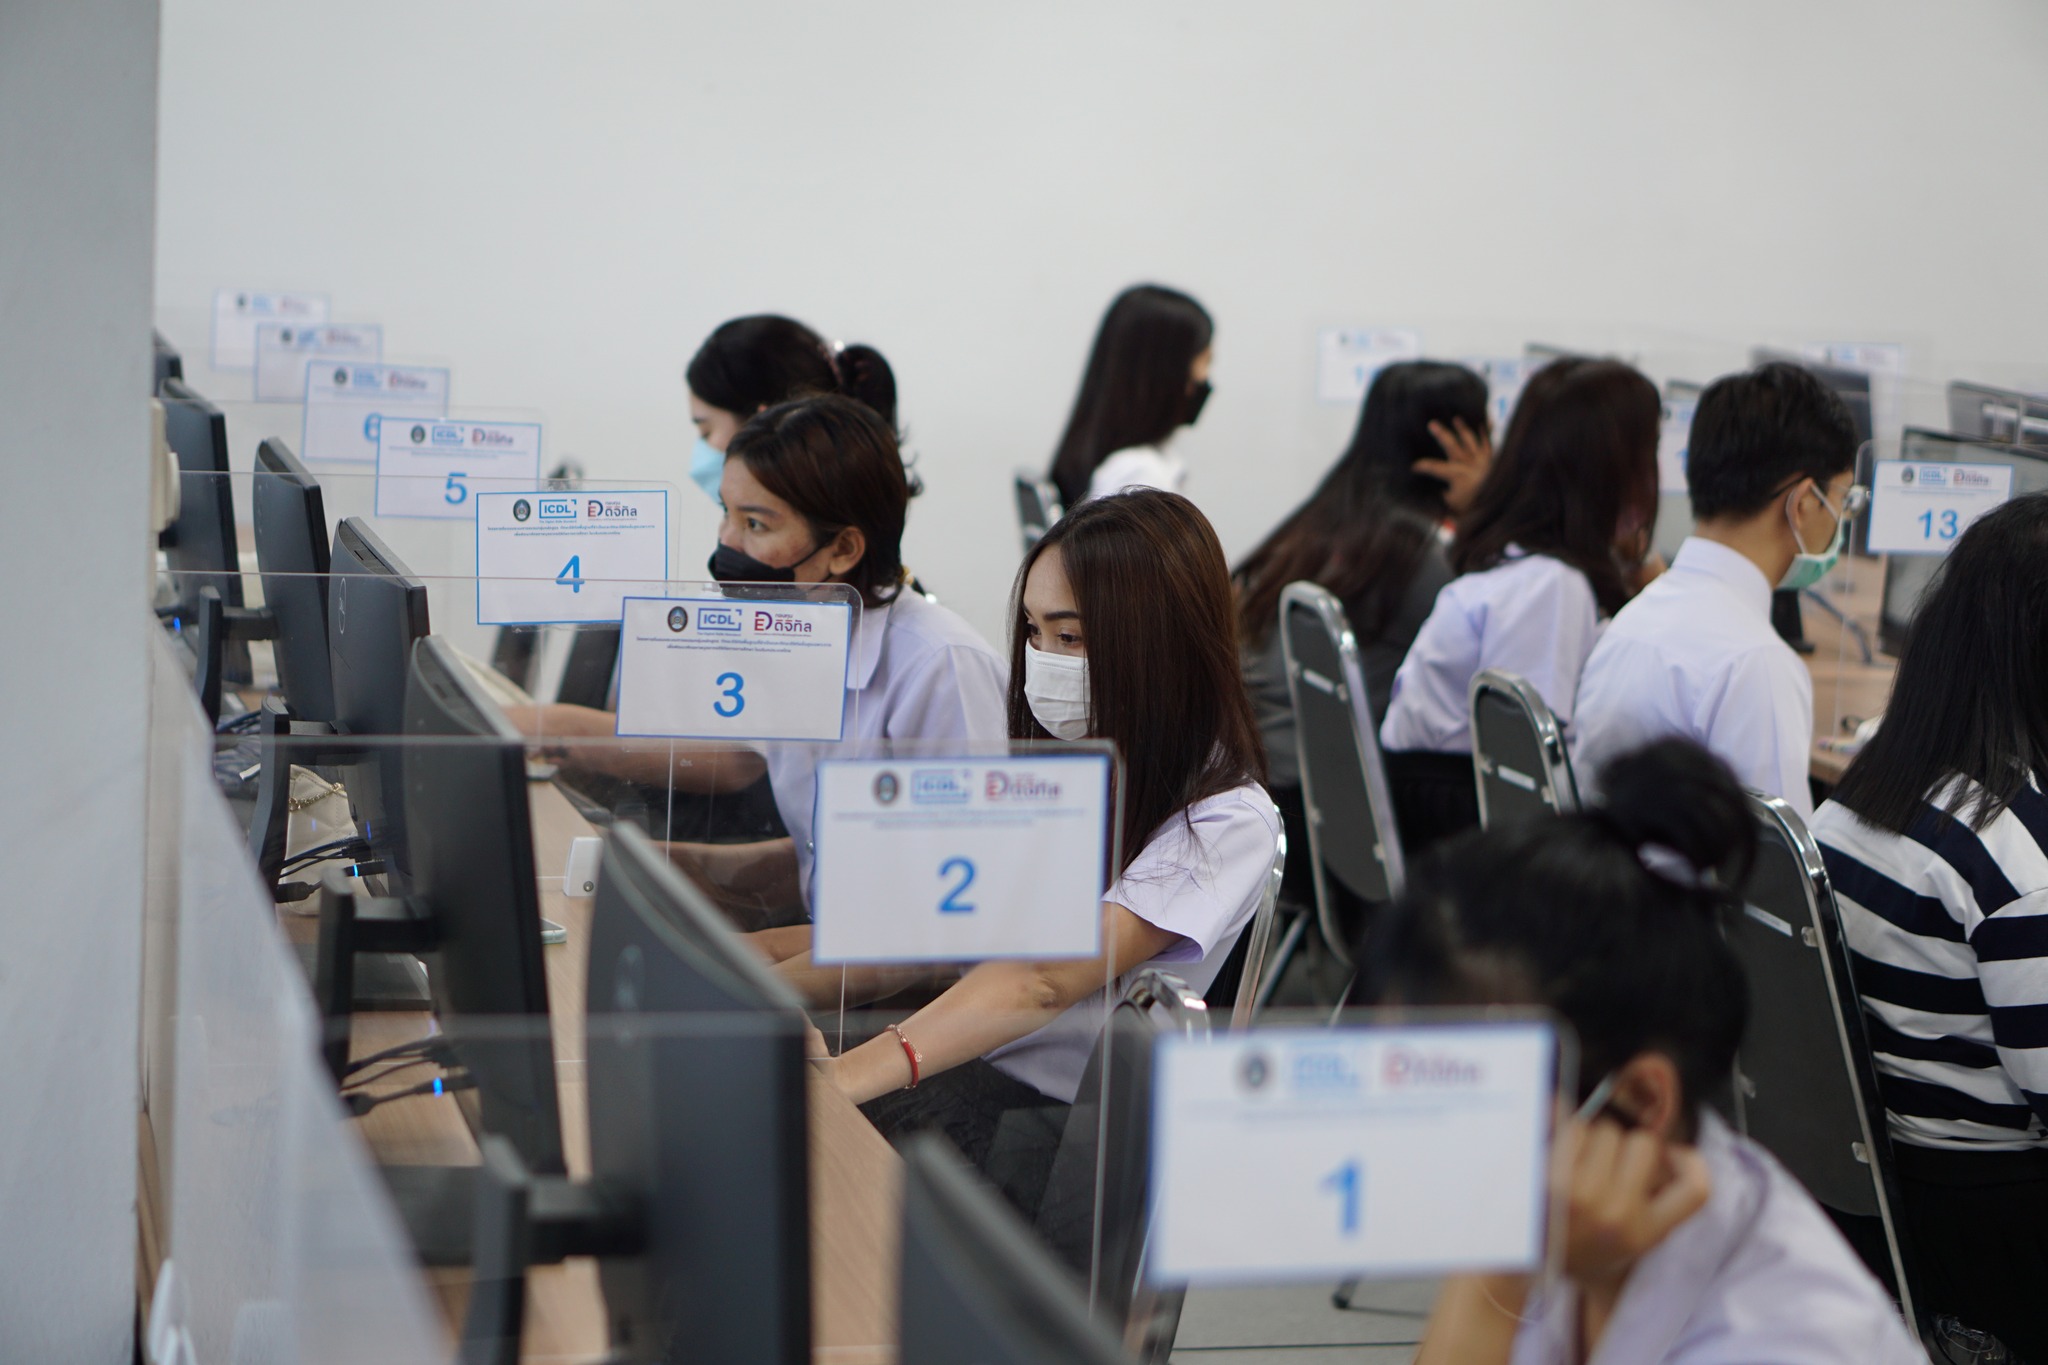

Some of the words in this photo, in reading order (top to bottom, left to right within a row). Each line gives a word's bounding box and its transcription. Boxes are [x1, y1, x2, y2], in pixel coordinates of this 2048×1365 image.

[445, 472, 467, 505] 5
[544, 504, 571, 514] ICDL
[1918, 508, 1959, 540] 13
[556, 554, 585, 594] 4
[703, 613, 735, 625] ICDL
[713, 671, 745, 718] 3
[937, 855, 977, 914] 2
[1320, 1158, 1362, 1238] 1
